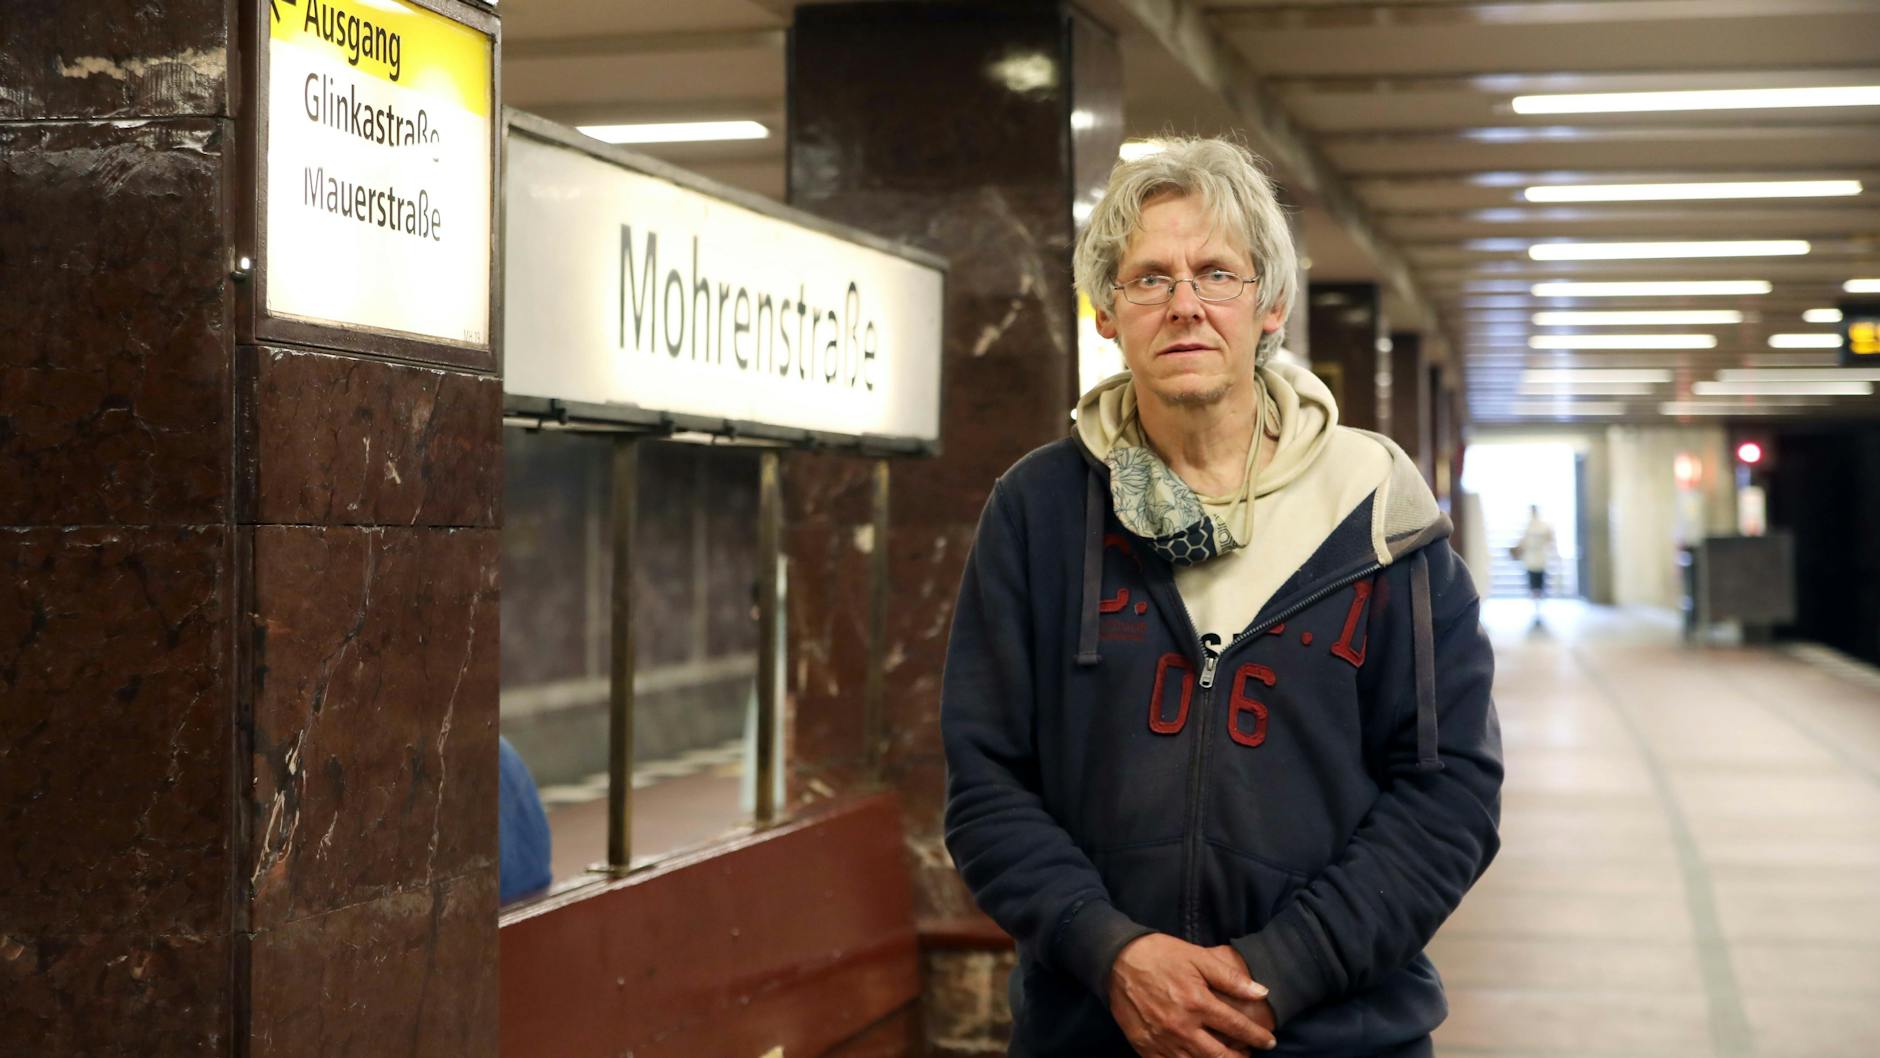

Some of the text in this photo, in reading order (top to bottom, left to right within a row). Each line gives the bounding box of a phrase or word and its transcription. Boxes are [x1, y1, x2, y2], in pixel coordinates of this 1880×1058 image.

[304, 0, 401, 82] Ausgang
[303, 166, 442, 242] Mauerstraße
[619, 222, 877, 392] Mohrenstraße
